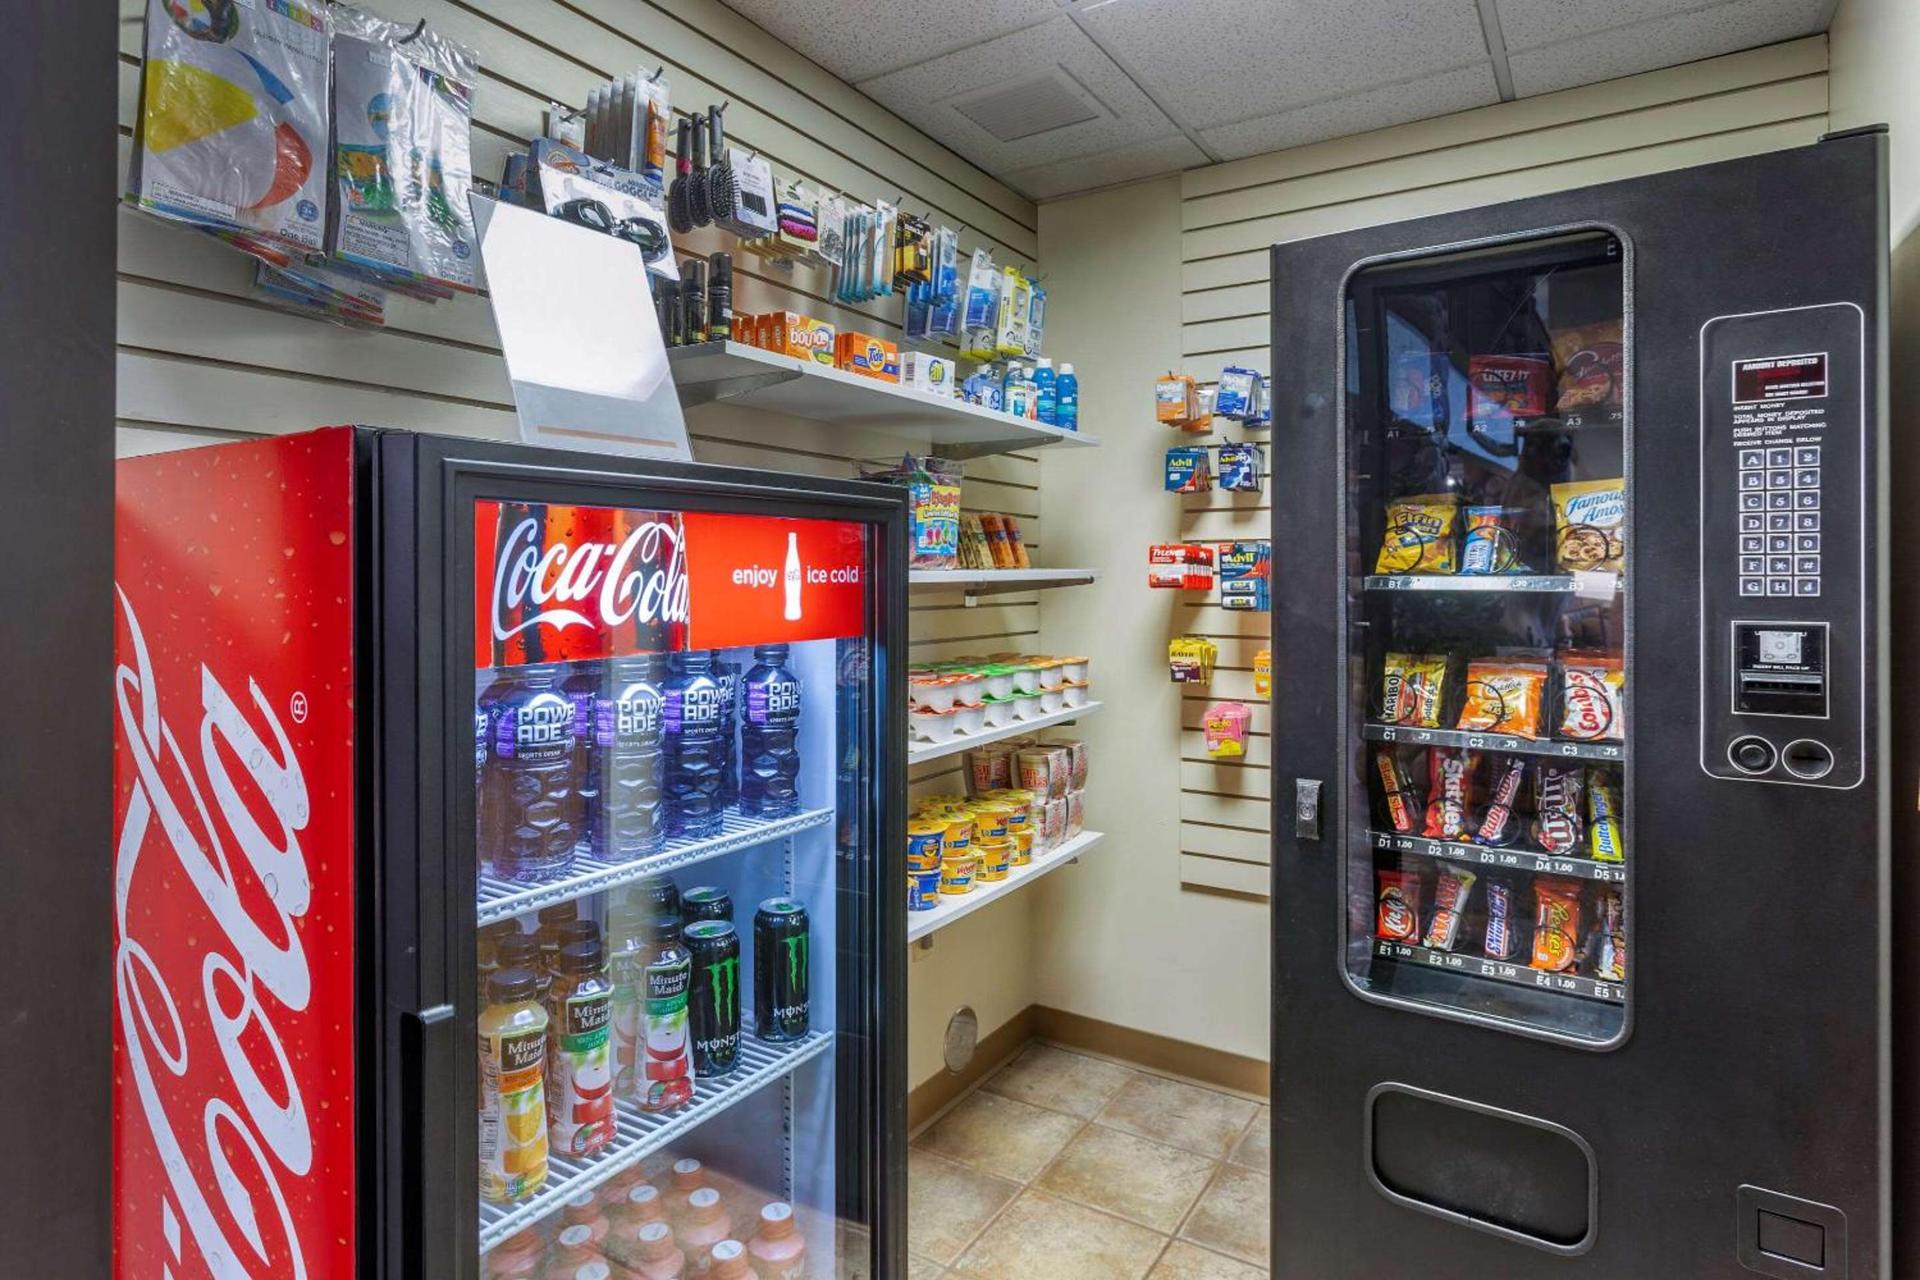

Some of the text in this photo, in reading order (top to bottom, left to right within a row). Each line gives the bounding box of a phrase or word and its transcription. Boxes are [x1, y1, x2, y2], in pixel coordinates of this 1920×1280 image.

[867, 346, 884, 362] Tide
[930, 361, 943, 379] all
[1566, 417, 1582, 426] A3
[1789, 422, 1827, 430] MATCHING
[1473, 424, 1487, 432] A2
[1747, 453, 1813, 465] A 1 2
[1748, 477, 1759, 486] B
[1803, 475, 1813, 484] 4
[1747, 496, 1813, 507] C 5 6
[1748, 518, 1813, 528] D 7 8
[1748, 539, 1813, 549] E 9 0
[1748, 562, 1759, 570] F
[491, 517, 690, 641] Coca-Cola
[732, 563, 778, 589] enjoy
[806, 565, 828, 584] ice
[830, 565, 859, 584] cold
[1747, 582, 1759, 591] G
[1775, 582, 1786, 592] H
[769, 680, 802, 697] POW
[768, 694, 799, 712] ADE
[1385, 677, 1400, 720] HARIBO
[684, 703, 719, 720] ADE
[618, 714, 657, 733] ADE
[517, 722, 562, 744] ADE
[1383, 731, 1396, 740] C1
[1470, 739, 1484, 747] C2
[1562, 746, 1578, 755] C3
[1443, 758, 1464, 835] Skittles
[1480, 806, 1508, 839] Baby
[1378, 839, 1413, 848] D1 1.00
[1428, 845, 1465, 856] D2 1.00
[1480, 853, 1517, 864] D3 1.00
[1536, 861, 1573, 872] D4 1.00
[1594, 869, 1610, 879] D5
[1380, 945, 1411, 956] E1 1.00
[1429, 955, 1462, 966] E2 1.00
[1482, 965, 1517, 976] E3 1.00
[650, 971, 688, 985] Minute
[1536, 976, 1576, 989] E4 1.00
[654, 982, 684, 995] Maid
[1594, 986, 1610, 998] E5
[697, 1030, 740, 1052] MONST
